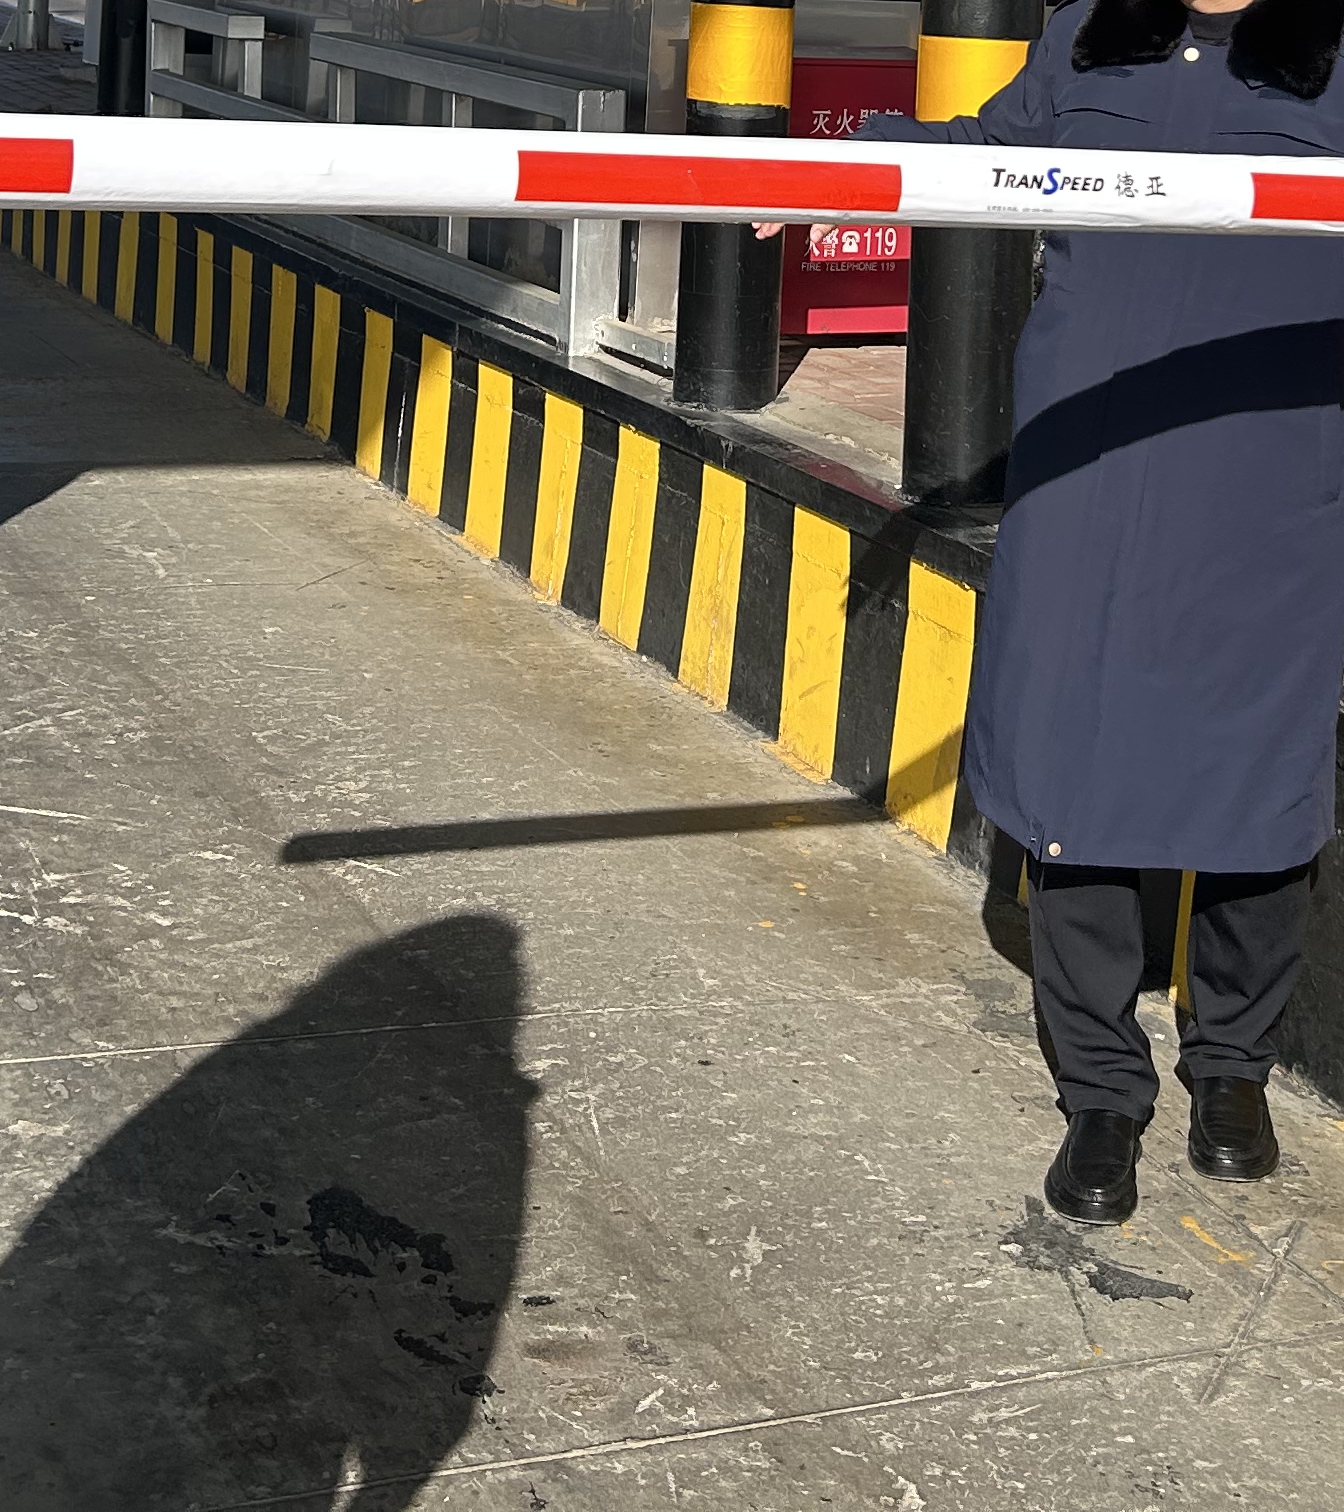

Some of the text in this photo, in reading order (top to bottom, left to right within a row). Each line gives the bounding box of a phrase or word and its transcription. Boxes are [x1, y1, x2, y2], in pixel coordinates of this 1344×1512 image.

[863, 227, 897, 256] 119
[801, 261, 896, 272] FIRE TELEPHONE 119
